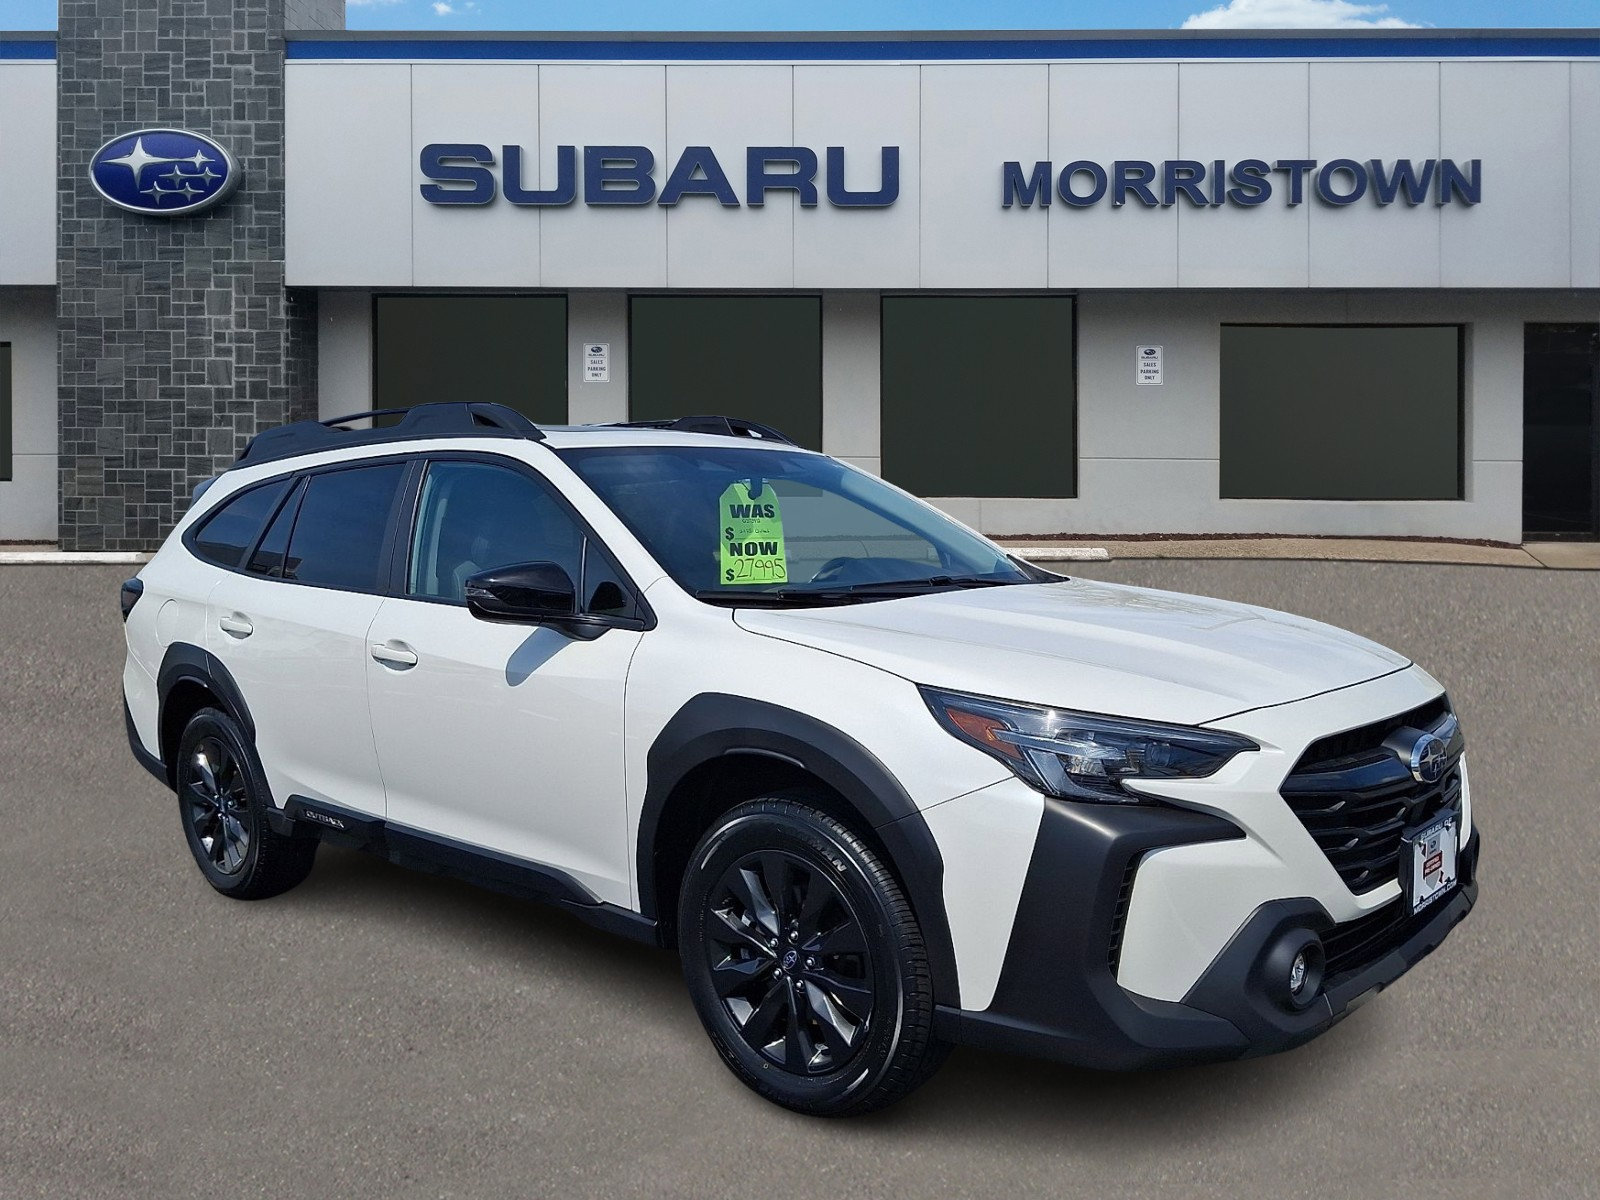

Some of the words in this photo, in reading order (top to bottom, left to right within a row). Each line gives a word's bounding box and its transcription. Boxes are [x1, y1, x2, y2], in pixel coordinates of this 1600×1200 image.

[420, 143, 900, 207] SUBARU
[1002, 159, 1482, 208] MORRISTOWN
[729, 504, 775, 519] WAS
[729, 541, 778, 557] NOW
[1421, 823, 1443, 840] SUBARU
